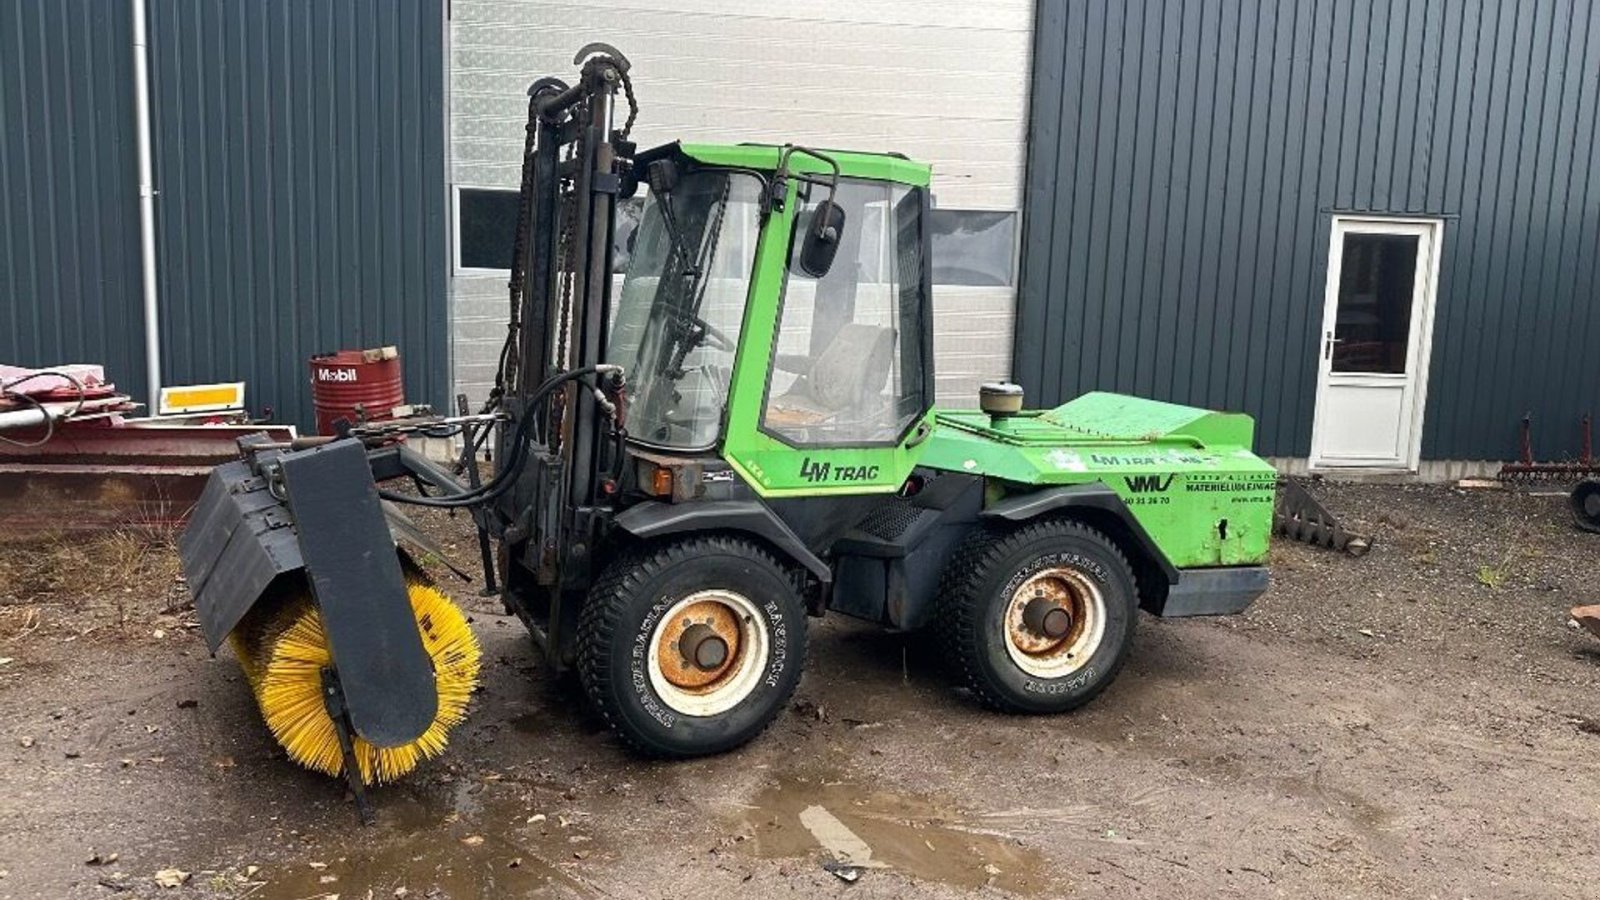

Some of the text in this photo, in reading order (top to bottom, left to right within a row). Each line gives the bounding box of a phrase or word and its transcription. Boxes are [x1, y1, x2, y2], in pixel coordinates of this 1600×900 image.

[318, 368, 357, 381] Mobil
[800, 457, 879, 482] LM TRAC
[1123, 472, 1177, 493] VMU
[1160, 496, 1170, 504] 70
